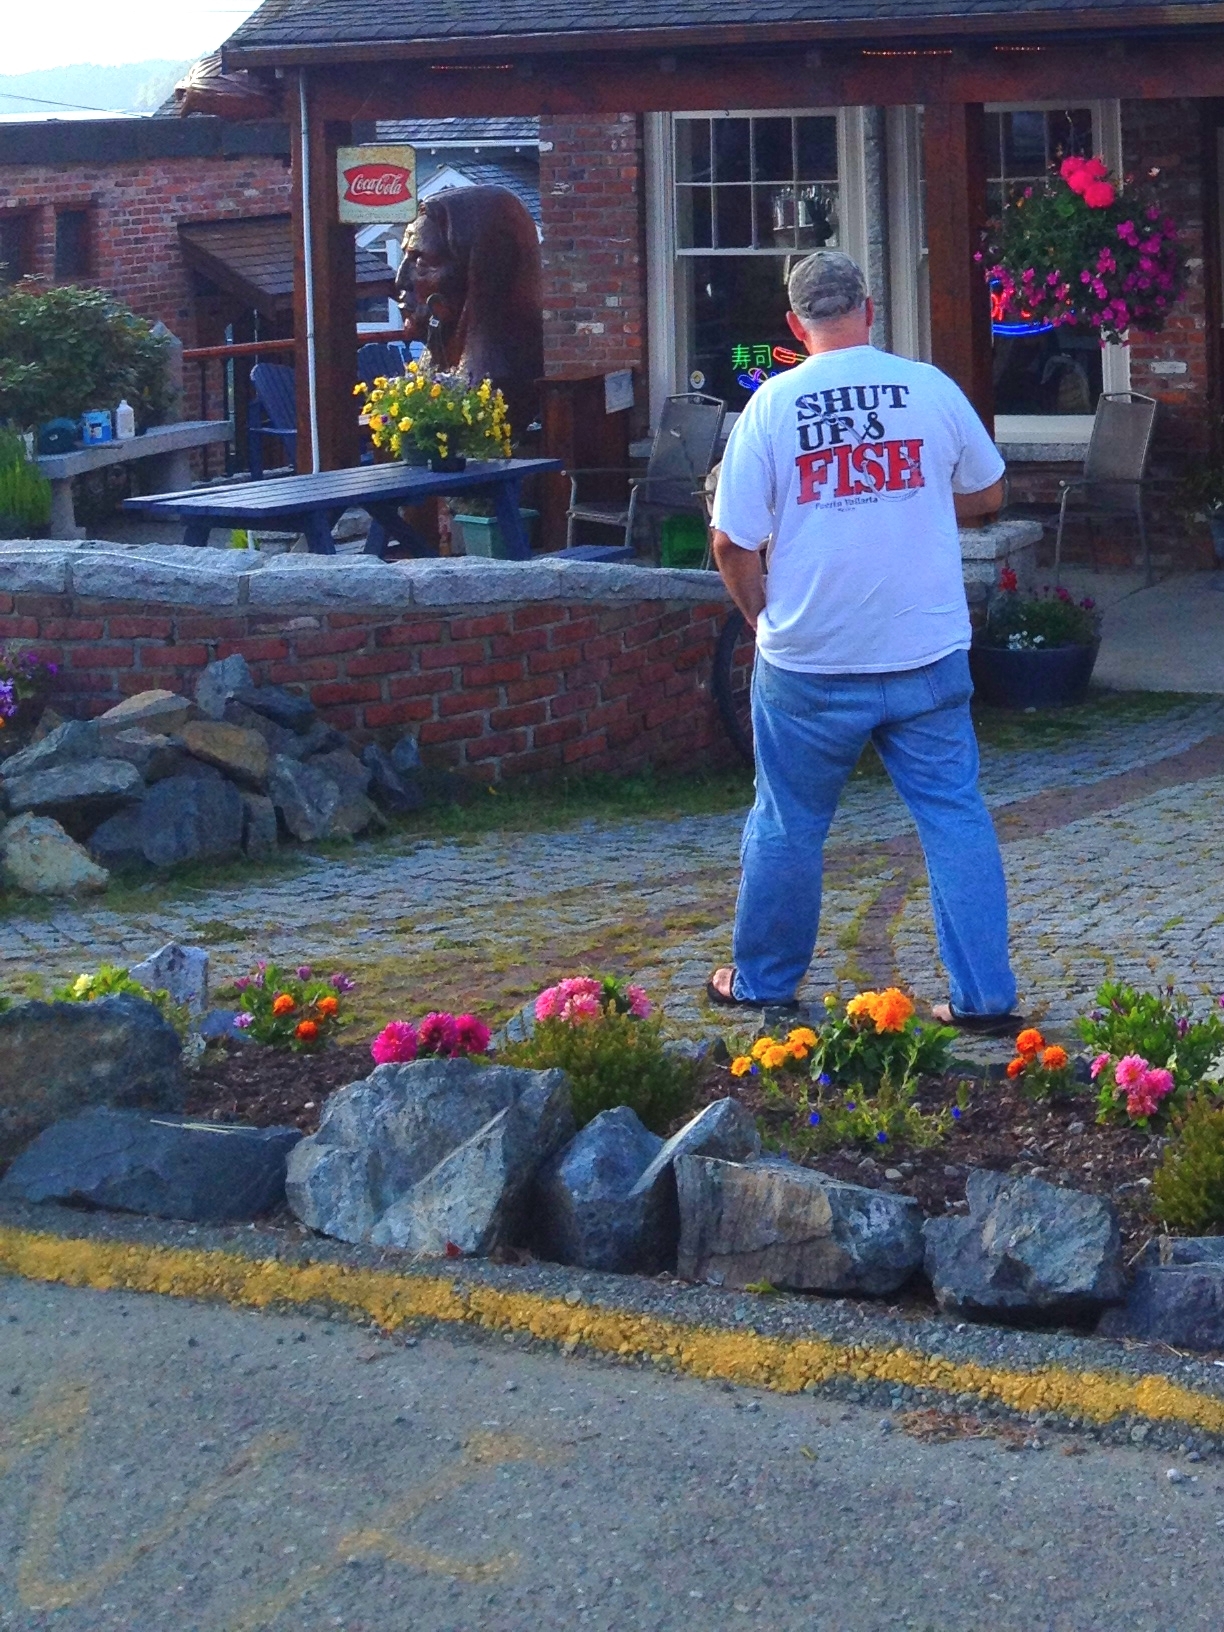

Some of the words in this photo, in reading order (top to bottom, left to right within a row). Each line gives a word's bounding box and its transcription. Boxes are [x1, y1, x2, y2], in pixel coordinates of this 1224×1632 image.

[731, 343, 772, 371] 寿司
[795, 384, 909, 421] SHUT
[797, 414, 854, 451] UP
[795, 439, 925, 505] FISH
